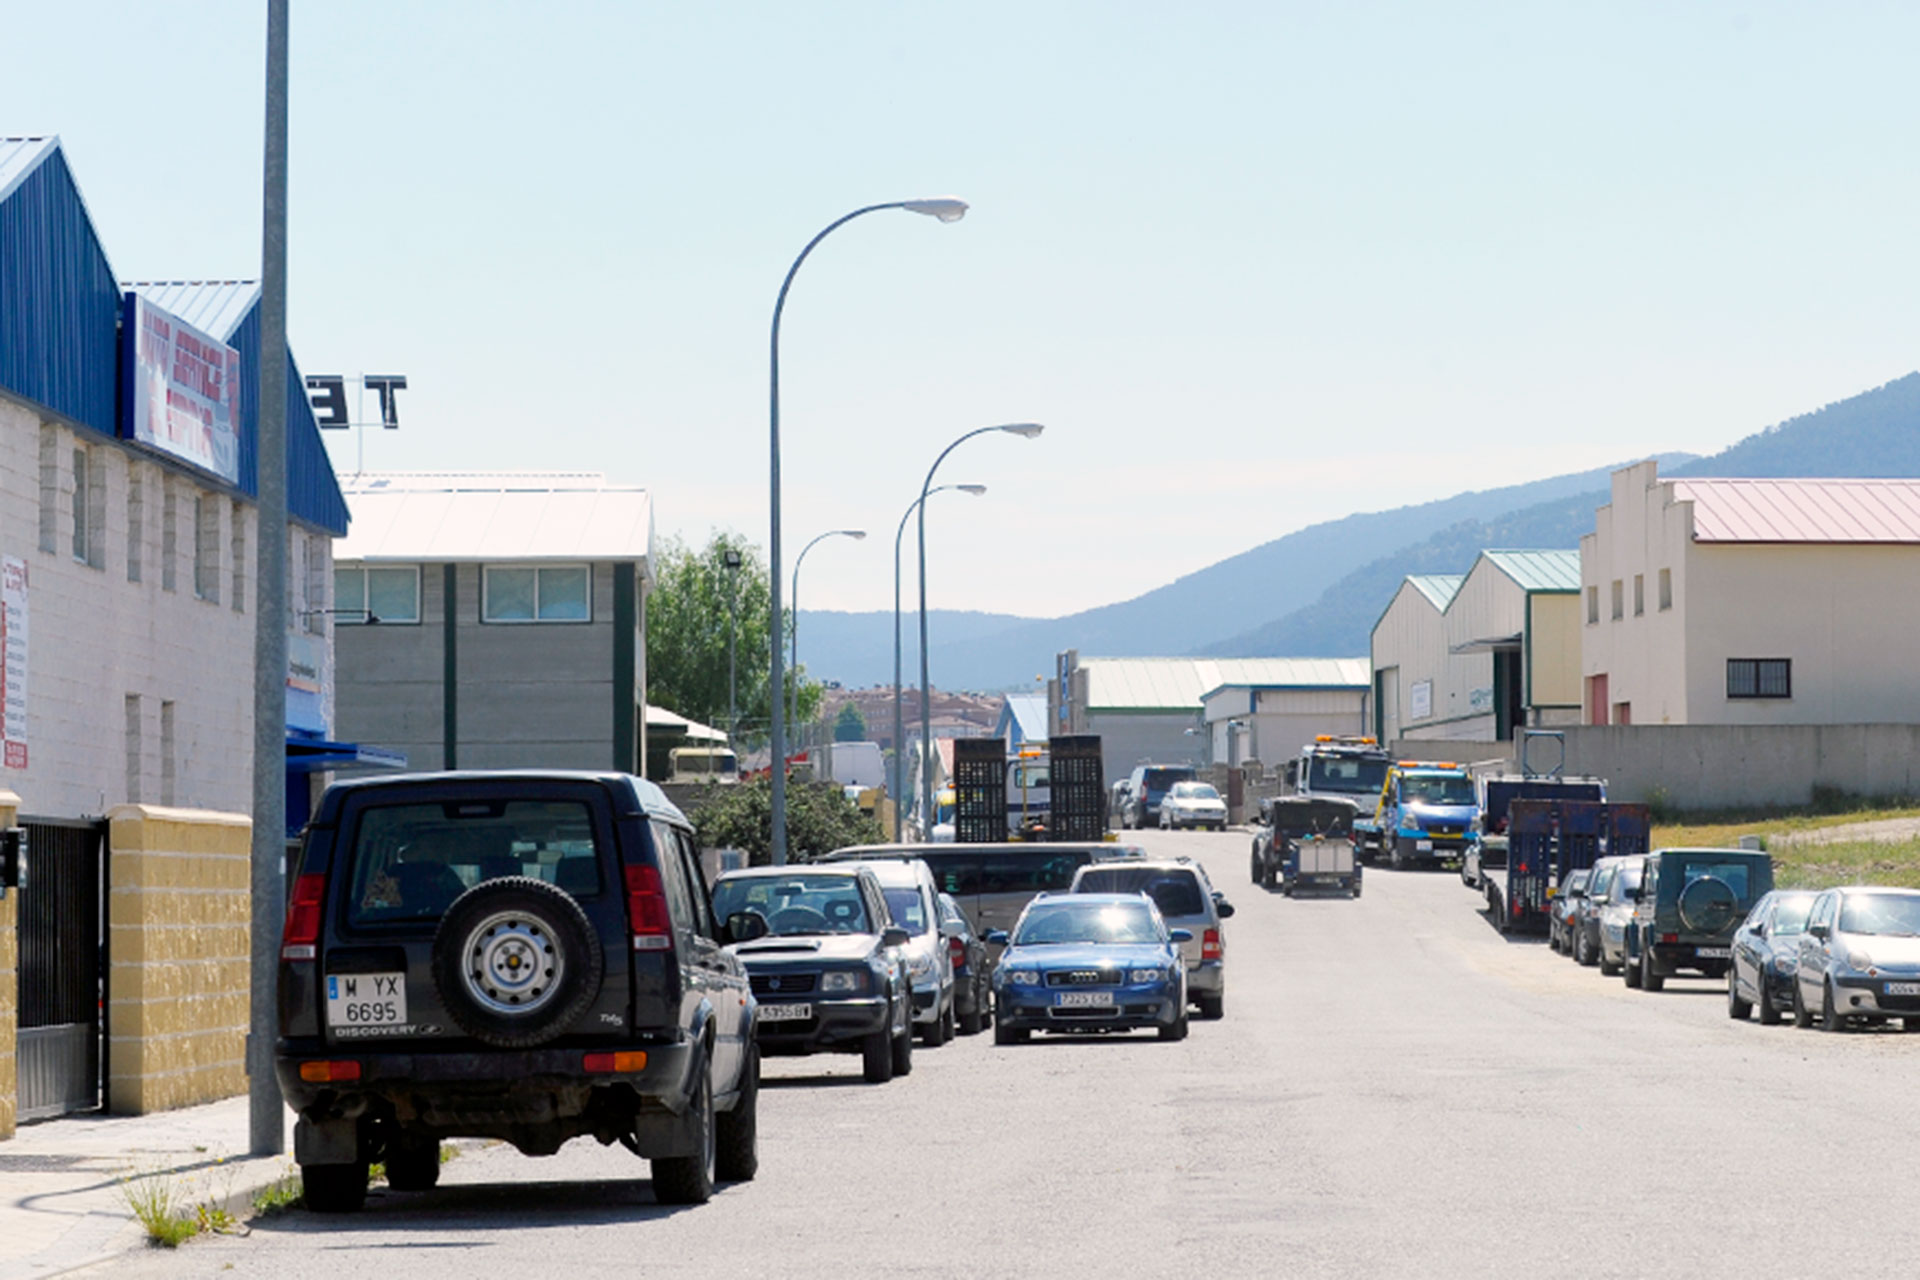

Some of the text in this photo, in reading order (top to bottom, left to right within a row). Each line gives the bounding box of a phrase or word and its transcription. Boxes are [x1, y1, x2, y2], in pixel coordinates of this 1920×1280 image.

[373, 976, 398, 996] YX
[346, 1002, 397, 1022] 6695
[335, 1025, 416, 1037] DISCOVERY
